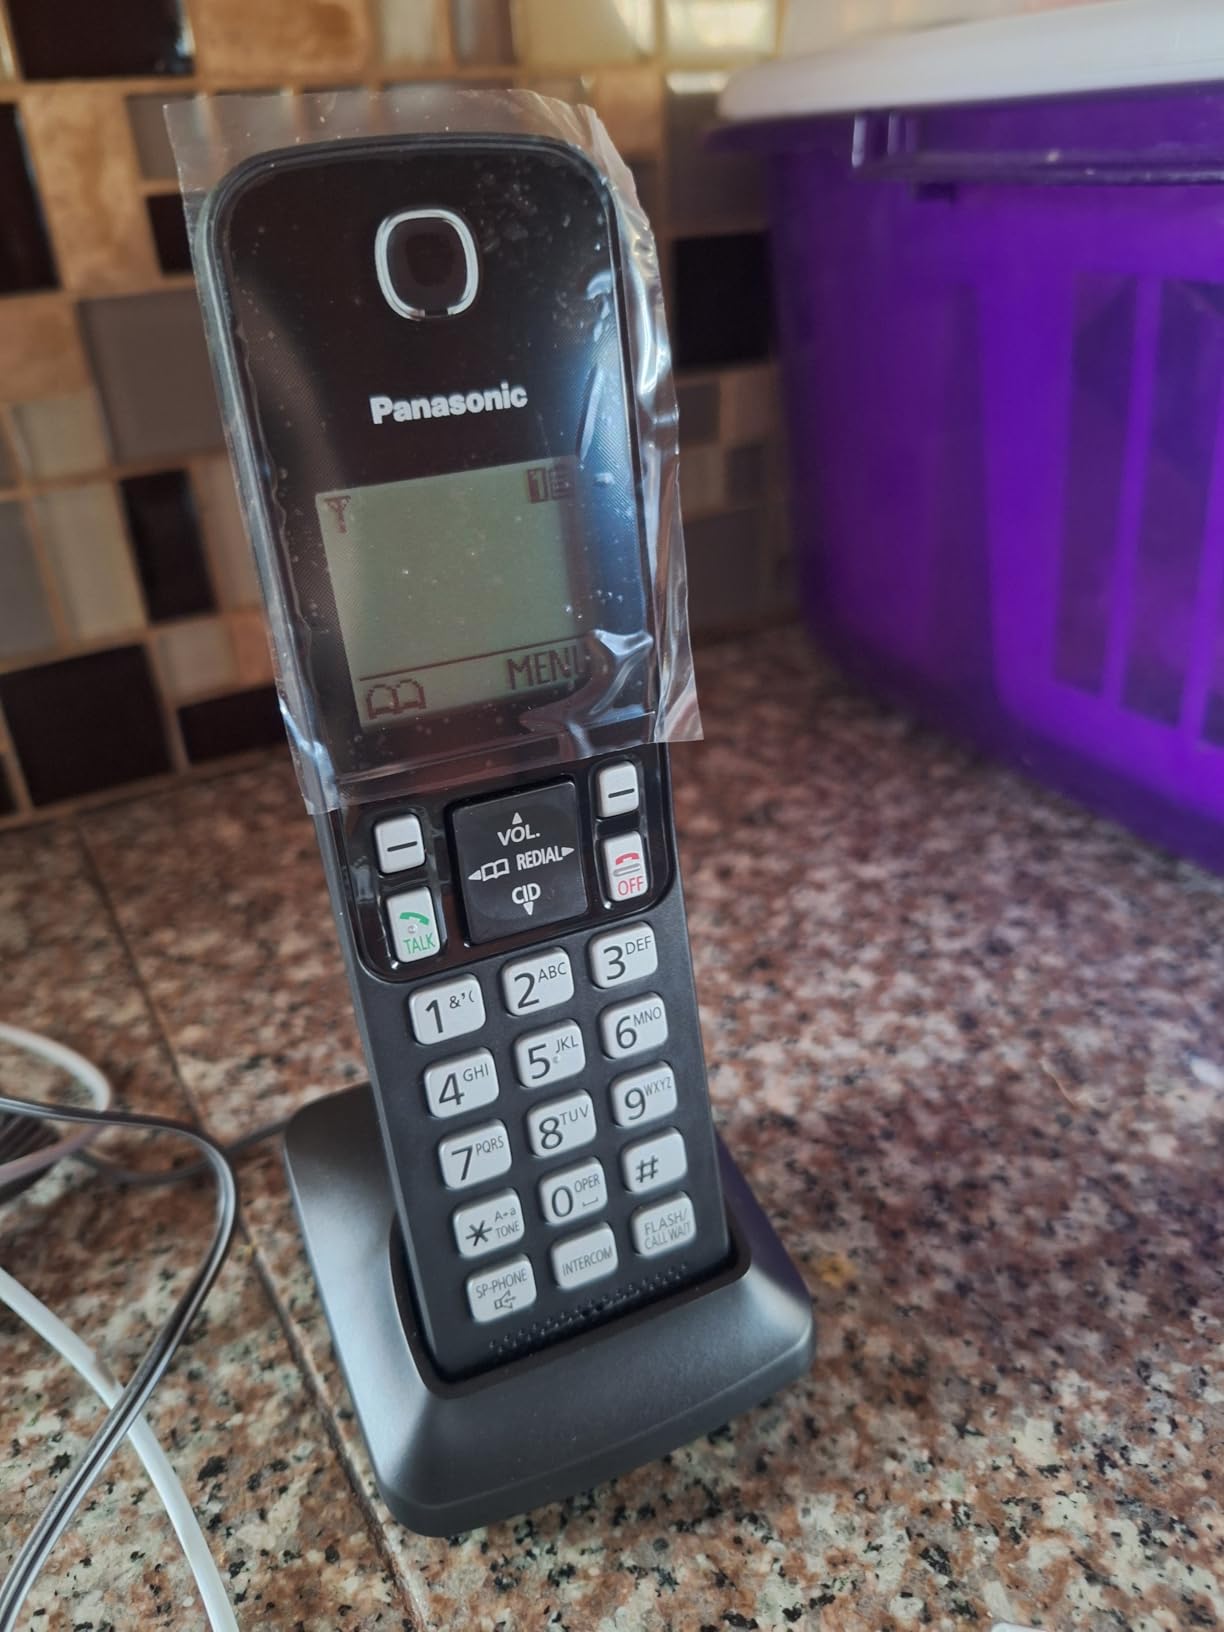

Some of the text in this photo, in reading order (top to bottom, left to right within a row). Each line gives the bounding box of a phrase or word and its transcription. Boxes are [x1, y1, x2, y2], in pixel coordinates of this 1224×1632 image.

[369, 381, 529, 425] Panasonic
[497, 824, 541, 846] VOL.
[516, 846, 563, 871] REDIAL
[511, 883, 541, 904] CID
[618, 877, 644, 897] OFF
[403, 932, 436, 955] TALK
[603, 936, 652, 981] 3 DEF
[514, 962, 568, 1009] 2 ABC
[425, 999, 444, 1034] 1
[615, 1006, 662, 1050] 6 MNO
[527, 1035, 579, 1080] 5 JKL
[438, 1063, 490, 1106] 4 GHI
[625, 1076, 672, 1121] 9 WXYZ
[539, 1104, 589, 1151] 8 TUV
[451, 1135, 505, 1181] 7 PQRS
[635, 1155, 659, 1184] #
[574, 1173, 600, 1193] OPER
[495, 1222, 521, 1240] TONE
[643, 1223, 692, 1250] CALL WAIT
[644, 1208, 689, 1236] FLASH/
[562, 1246, 614, 1277] INTERCOM
[475, 1267, 528, 1299] SP-PHONE
